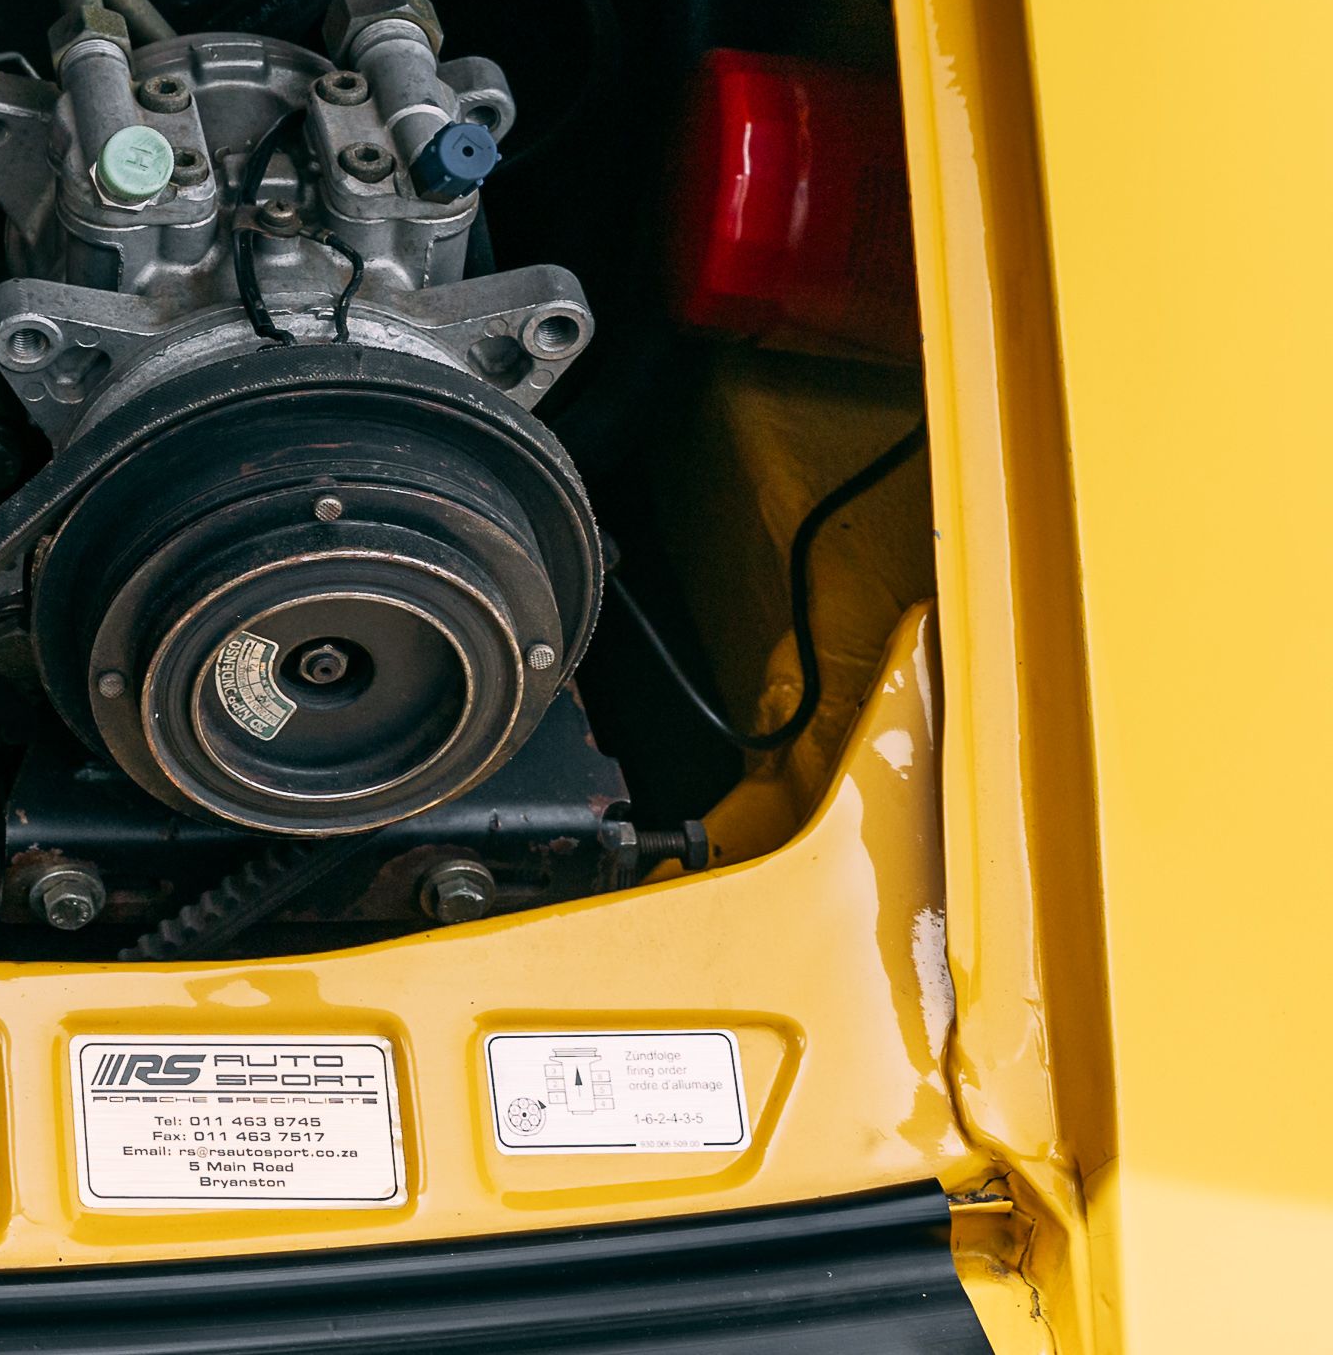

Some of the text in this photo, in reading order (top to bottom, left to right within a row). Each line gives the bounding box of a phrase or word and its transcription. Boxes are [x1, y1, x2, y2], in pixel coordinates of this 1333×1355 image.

[214, 1054, 343, 1067] AUTO
[626, 1065, 687, 1077] firing order
[215, 1074, 375, 1087] SPORT
[629, 1080, 723, 1092] ordre d'allumage
[92, 1096, 378, 1105] PORSCHE SPECIALISTS
[154, 1116, 321, 1127] Tel: 011 463 8745
[634, 1112, 704, 1125] 1-6-2-4-3-5
[152, 1131, 325, 1143] Fax: 011 463 7517
[122, 1146, 359, 1160] Email: rs@rsautosport.co.za
[189, 1161, 294, 1173] 5 Main Road
[199, 1176, 286, 1189] Bryanston
